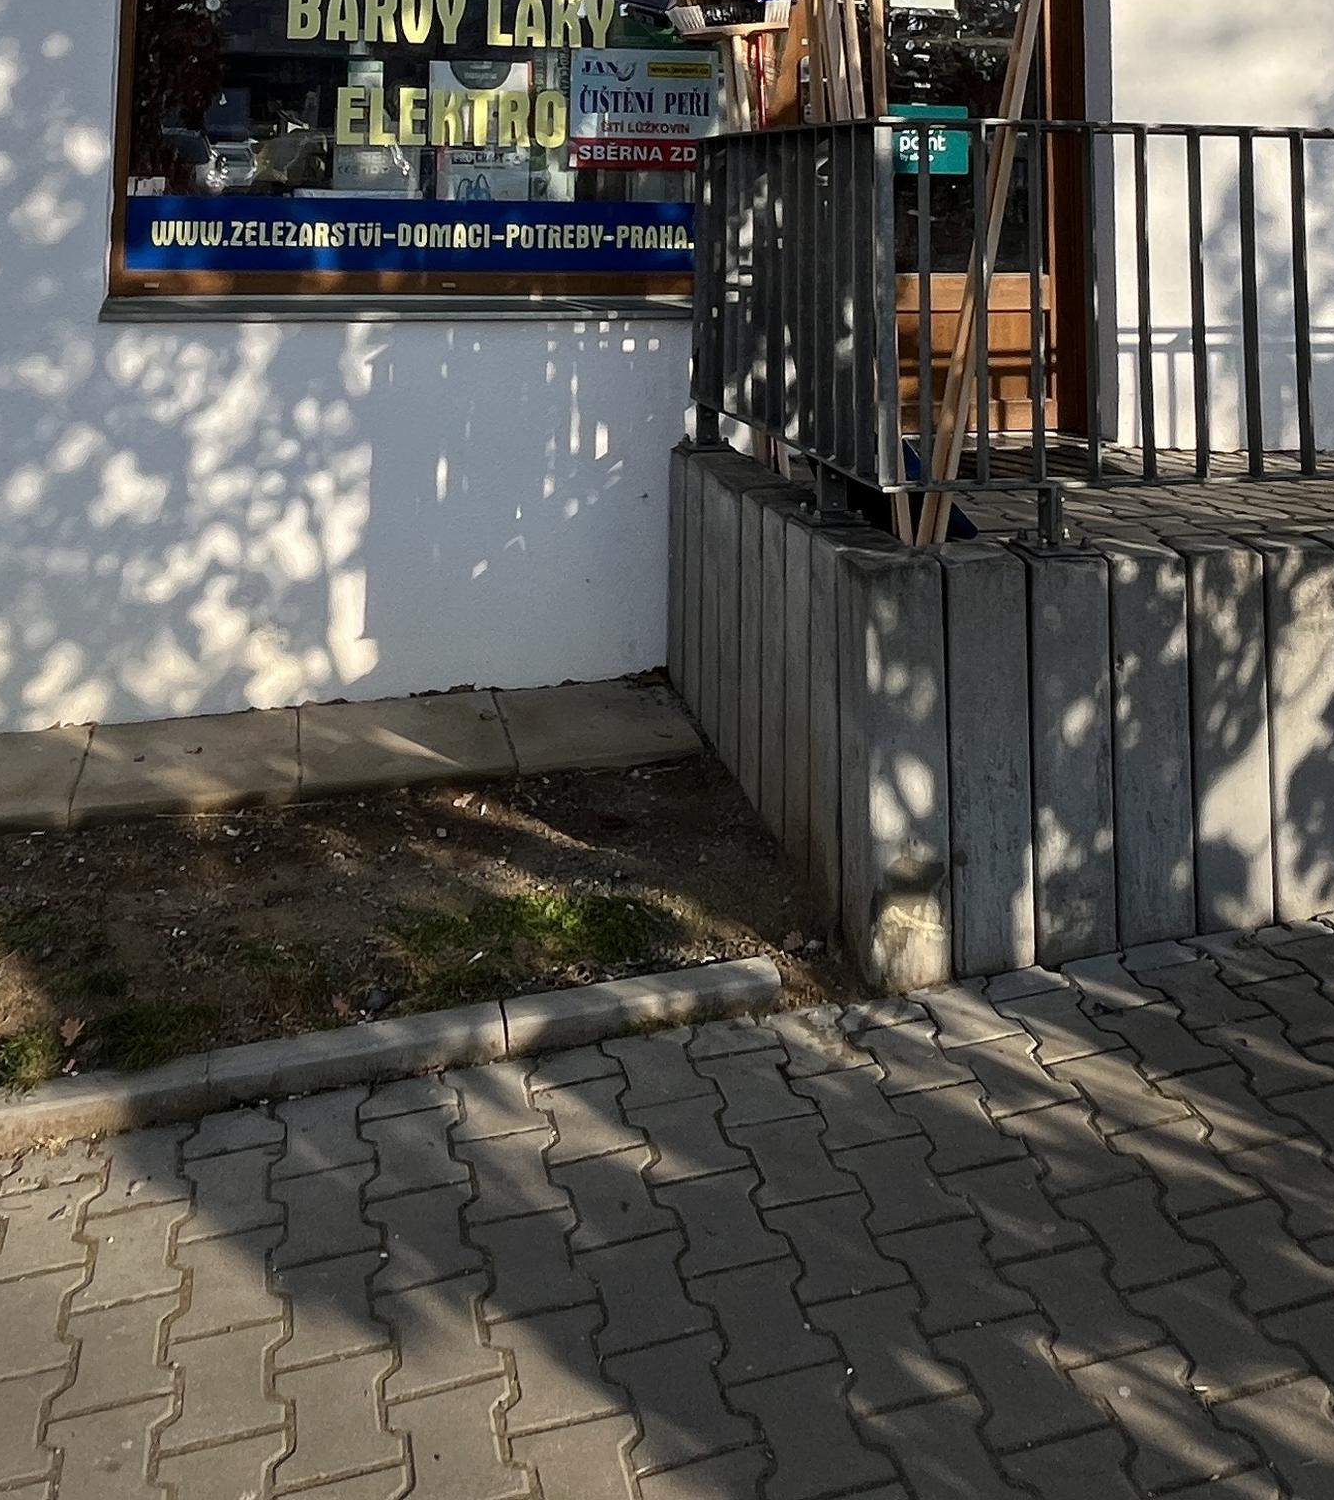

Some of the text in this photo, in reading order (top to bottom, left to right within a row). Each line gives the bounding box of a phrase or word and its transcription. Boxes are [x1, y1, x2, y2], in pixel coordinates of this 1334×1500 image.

[579, 84, 710, 117] ČIŠTĚNÍ PEŘÍ
[336, 86, 567, 149] ELEKTRO
[578, 142, 664, 161] SBĚRNA
[899, 135, 947, 152] pont
